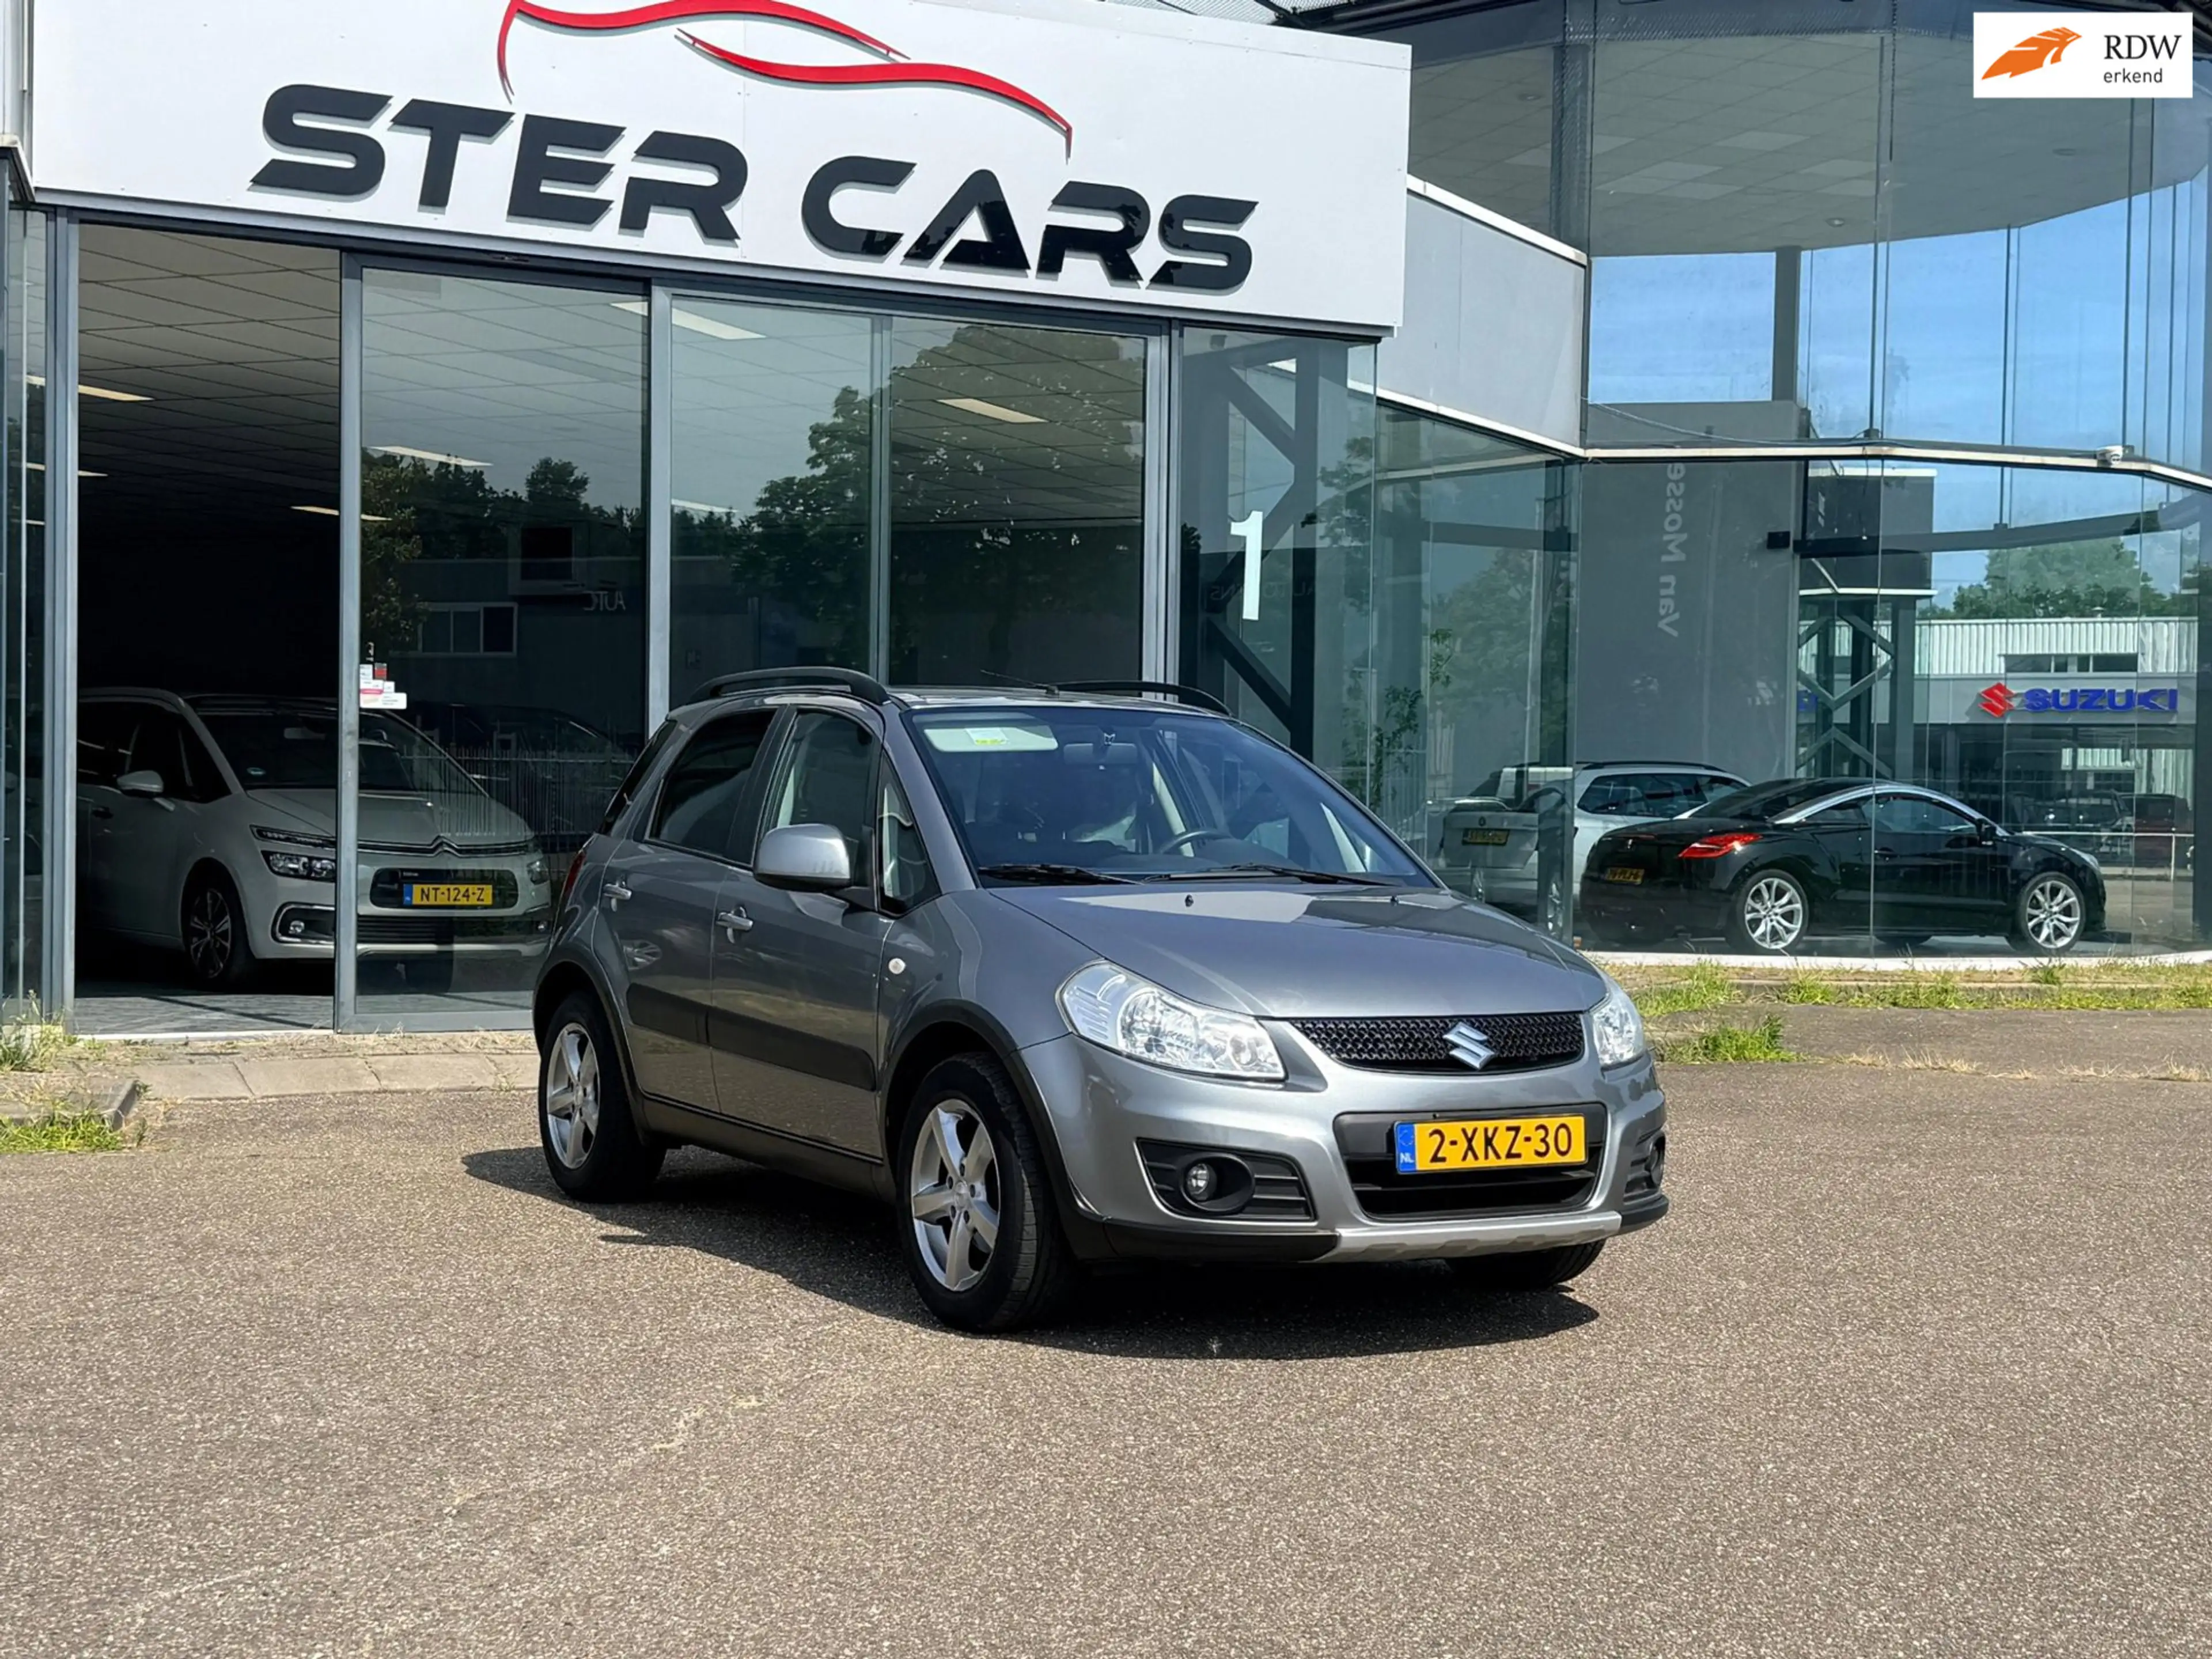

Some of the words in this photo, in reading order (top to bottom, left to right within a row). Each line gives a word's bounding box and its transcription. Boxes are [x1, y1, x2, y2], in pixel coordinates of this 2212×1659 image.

[250, 84, 748, 243] STER
[801, 155, 1259, 293] CARS
[1230, 510, 1263, 621] 1
[2023, 688, 2179, 712] SUZUKI
[421, 887, 484, 902] NT-124-Z
[1400, 1153, 1414, 1164] NL
[1429, 1122, 1572, 1164] 2-XKZ-30
